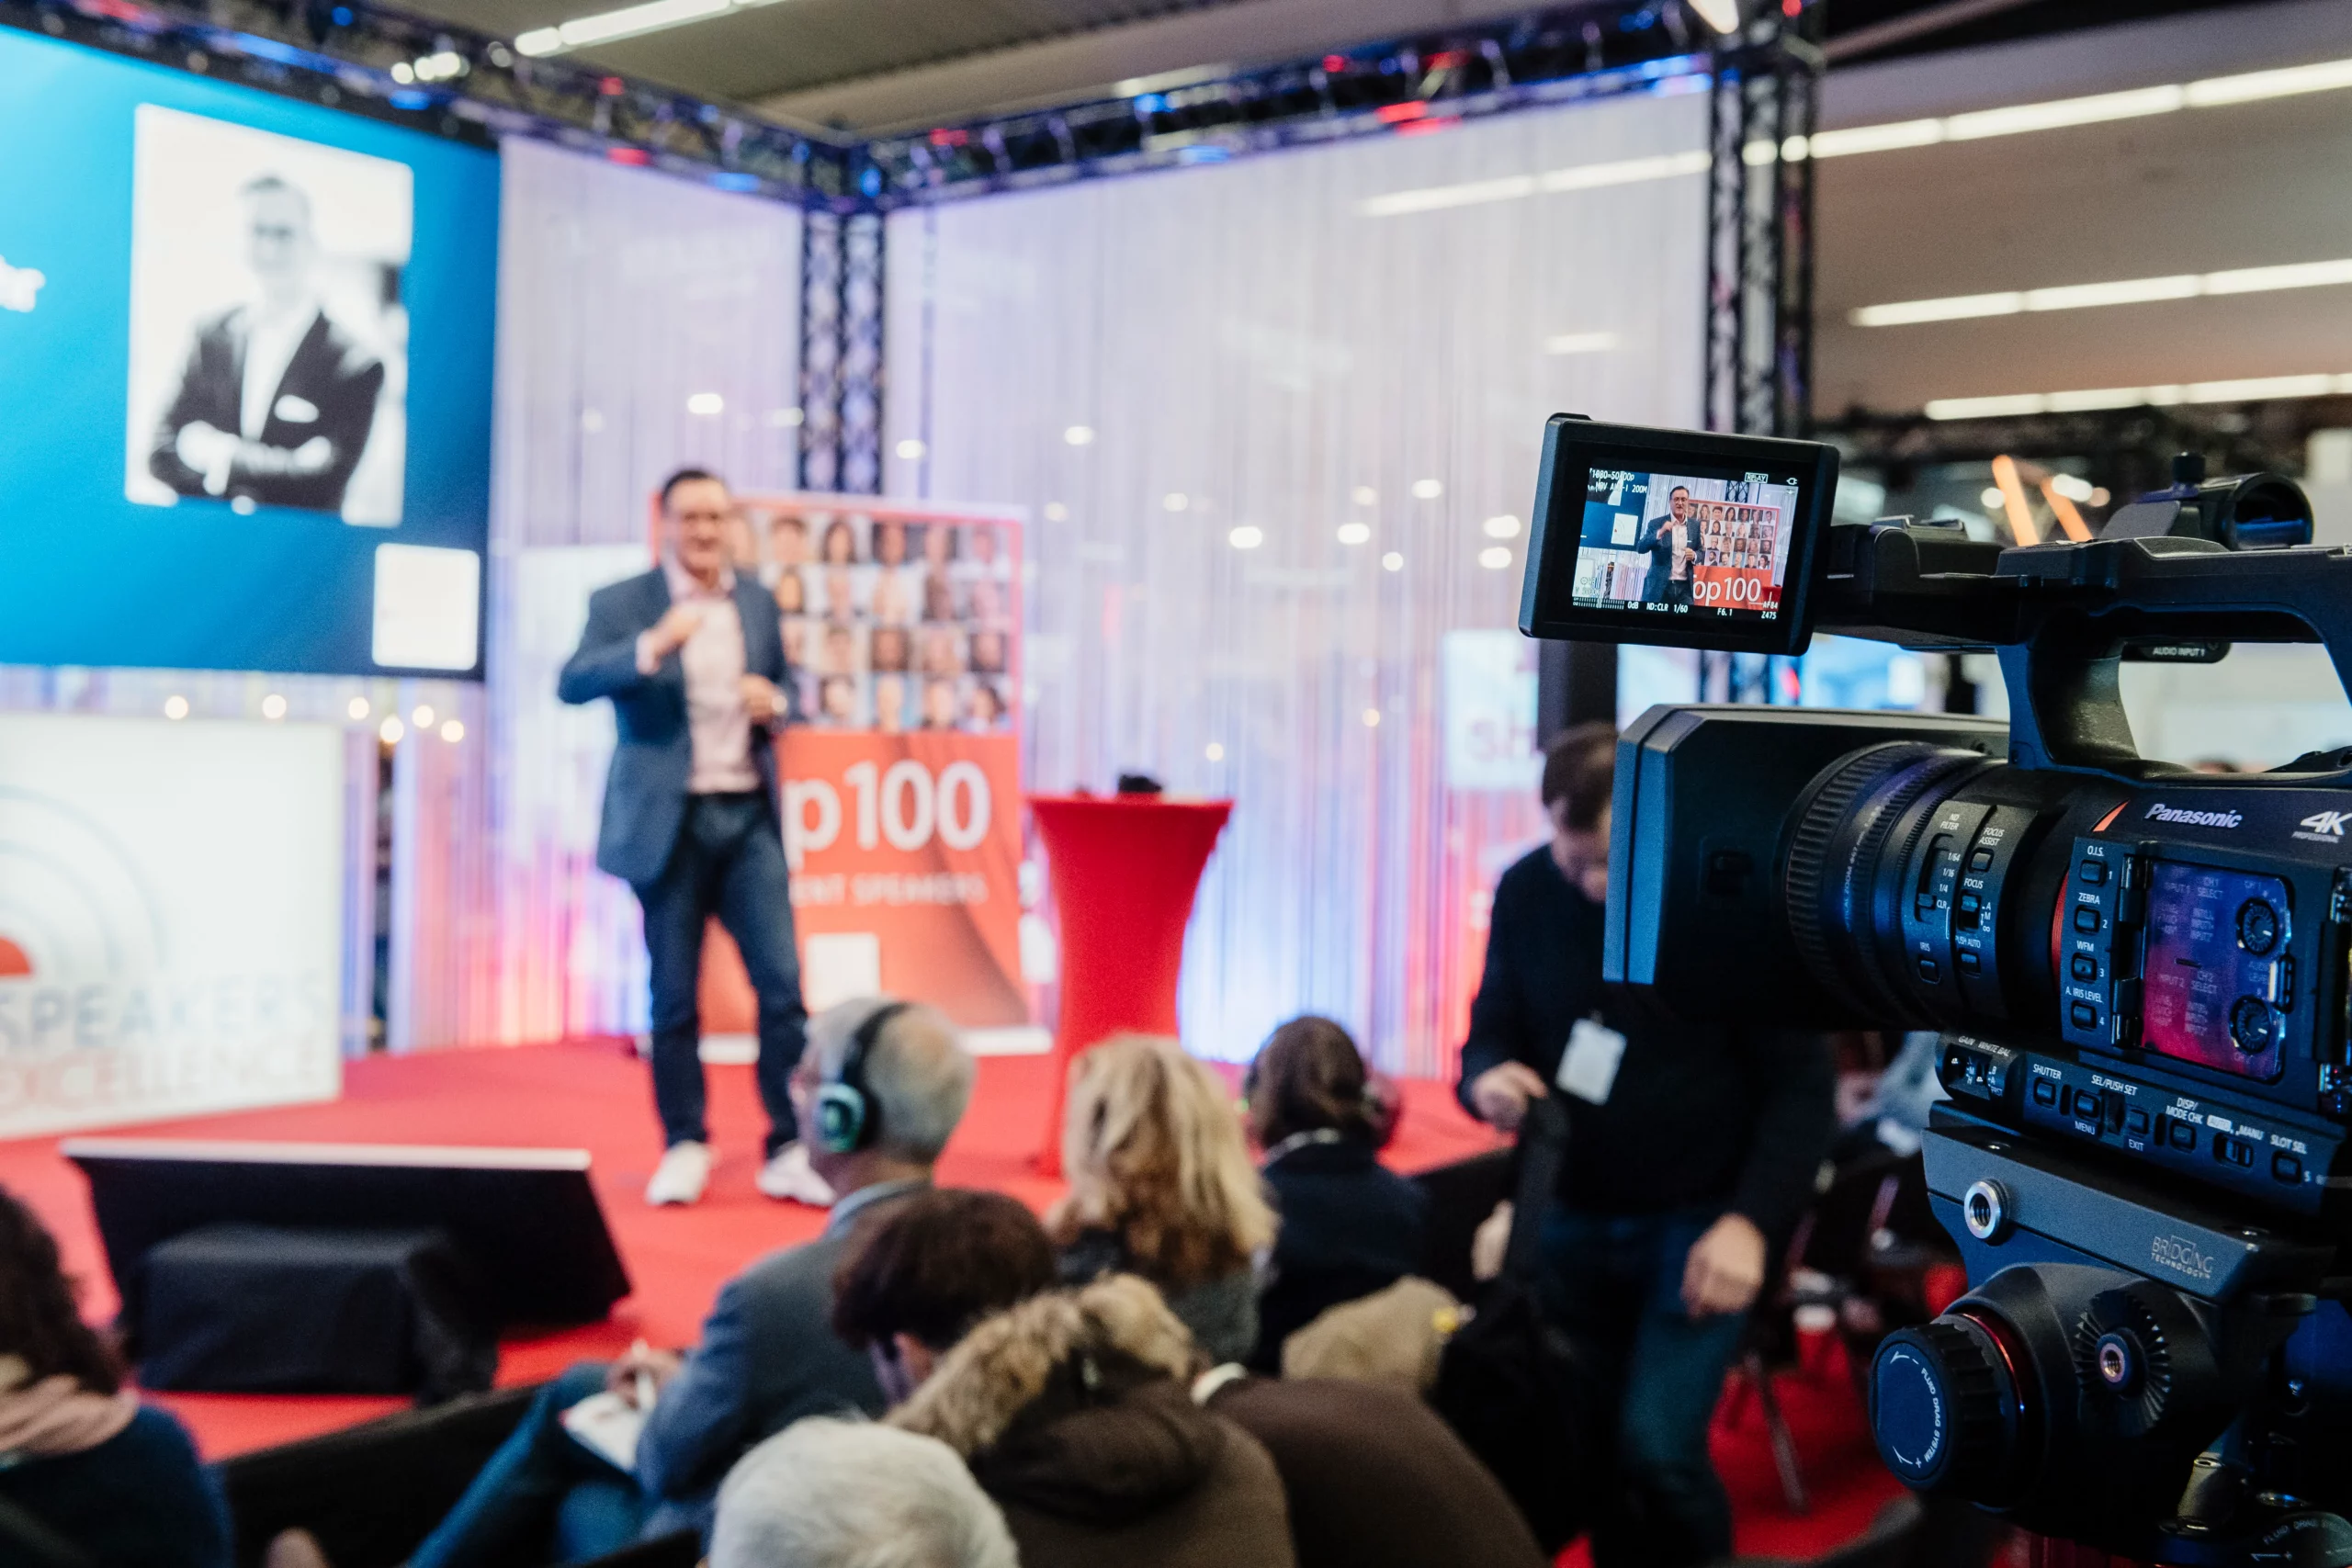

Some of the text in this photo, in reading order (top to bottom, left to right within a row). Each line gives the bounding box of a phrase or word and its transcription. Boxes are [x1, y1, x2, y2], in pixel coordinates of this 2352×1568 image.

[1646, 603, 1668, 612] ND:CLR
[1673, 604, 1689, 614] 1/60
[1761, 611, 1777, 620] Z475
[2153, 647, 2177, 656] AUDIO
[1949, 813, 1961, 821] ND
[2144, 803, 2243, 829] Panasonic
[1939, 821, 1960, 830] FILTER
[2300, 811, 2352, 836] 4K
[1984, 827, 2005, 838] FOCUS
[1978, 837, 2001, 846] ASSIST
[1948, 852, 1962, 862] 1/64
[1942, 868, 1955, 878] 1/16
[2108, 870, 2113, 880] 1
[1939, 884, 1949, 893] 1/4
[1963, 878, 1984, 889] FOCUS
[1936, 899, 1948, 909] CLR
[2078, 892, 2101, 905] ZEBRA
[1985, 902, 1992, 911] A
[2102, 919, 2109, 929] 2
[1919, 942, 1931, 952] IRIS
[1967, 939, 1981, 948] AUTO
[2076, 940, 2095, 953] WFM
[2098, 967, 2105, 977] 3
[2073, 987, 2085, 998] IRIS
[2085, 990, 2104, 1003] LEVEL
[2098, 1016, 2105, 1026] 4
[1958, 1035, 2011, 1057] GAIN WHITE BAL
[2032, 1064, 2062, 1080] SHUTTER
[2091, 1074, 2139, 1096] SEL/PUSH SET
[2176, 1097, 2199, 1111] DISP/
[2165, 1105, 2204, 1125] MODE CHK
[2075, 1120, 2096, 1135] MENU
[2239, 1124, 2265, 1141] MANU
[2128, 1138, 2144, 1152] EXIT
[2270, 1134, 2308, 1155] SLOT SEL
[1921, 1367, 1941, 1462] FLUID DRAG SYSTEM
